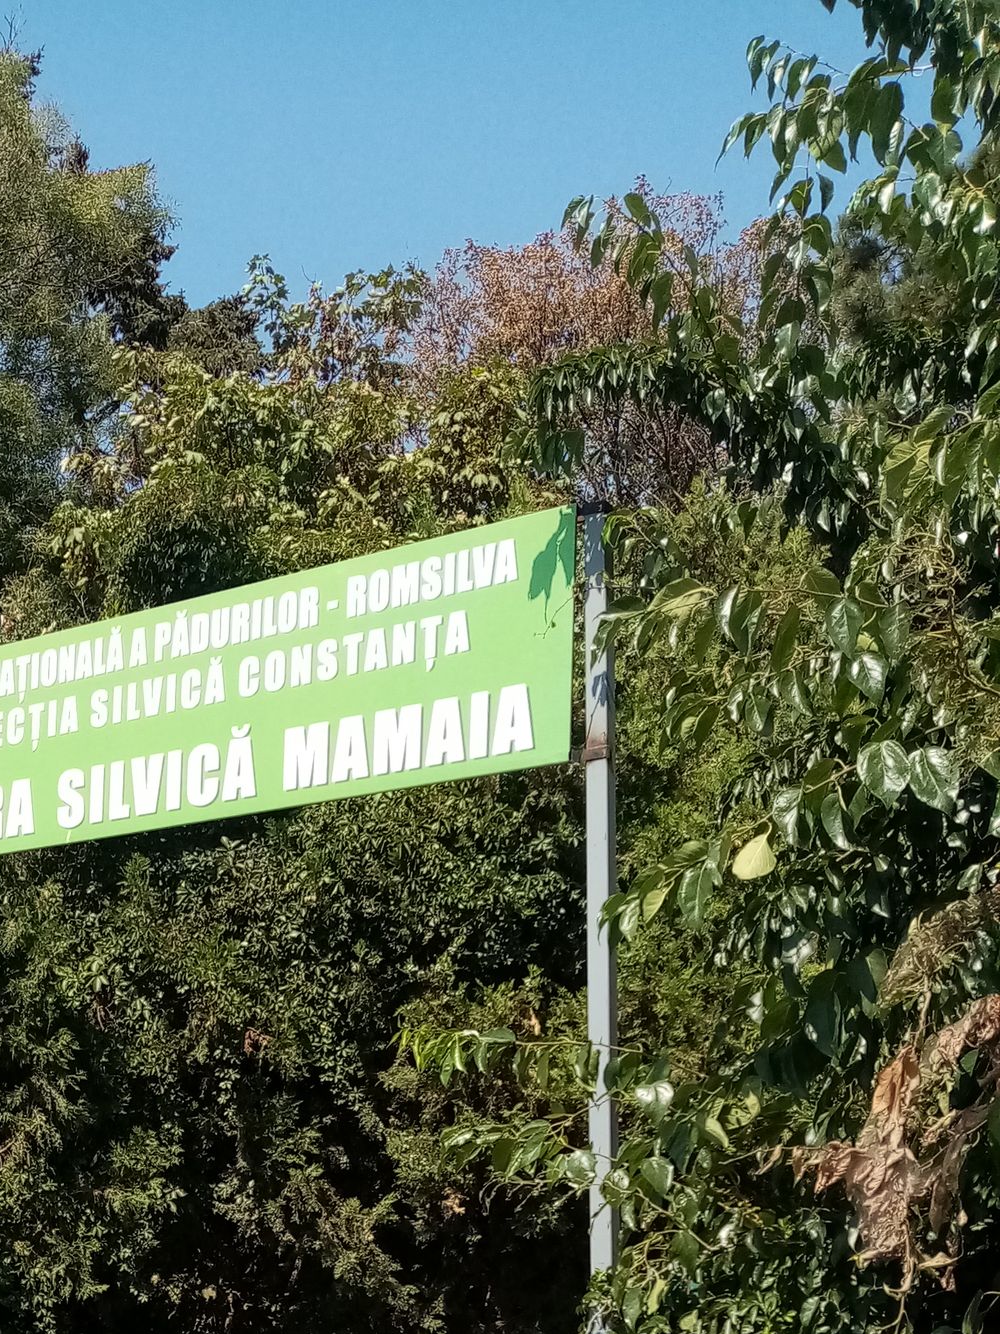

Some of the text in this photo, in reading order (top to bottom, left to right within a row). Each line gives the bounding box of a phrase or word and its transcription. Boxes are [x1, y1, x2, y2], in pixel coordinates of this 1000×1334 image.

[129, 627, 148, 668] A
[154, 585, 320, 663] PĂDURILOR
[346, 538, 519, 618] ROMSILVA
[56, 723, 257, 829] SILVICĂ
[282, 683, 536, 792] MAMAIA
[90, 656, 226, 729] SILVICĂ
